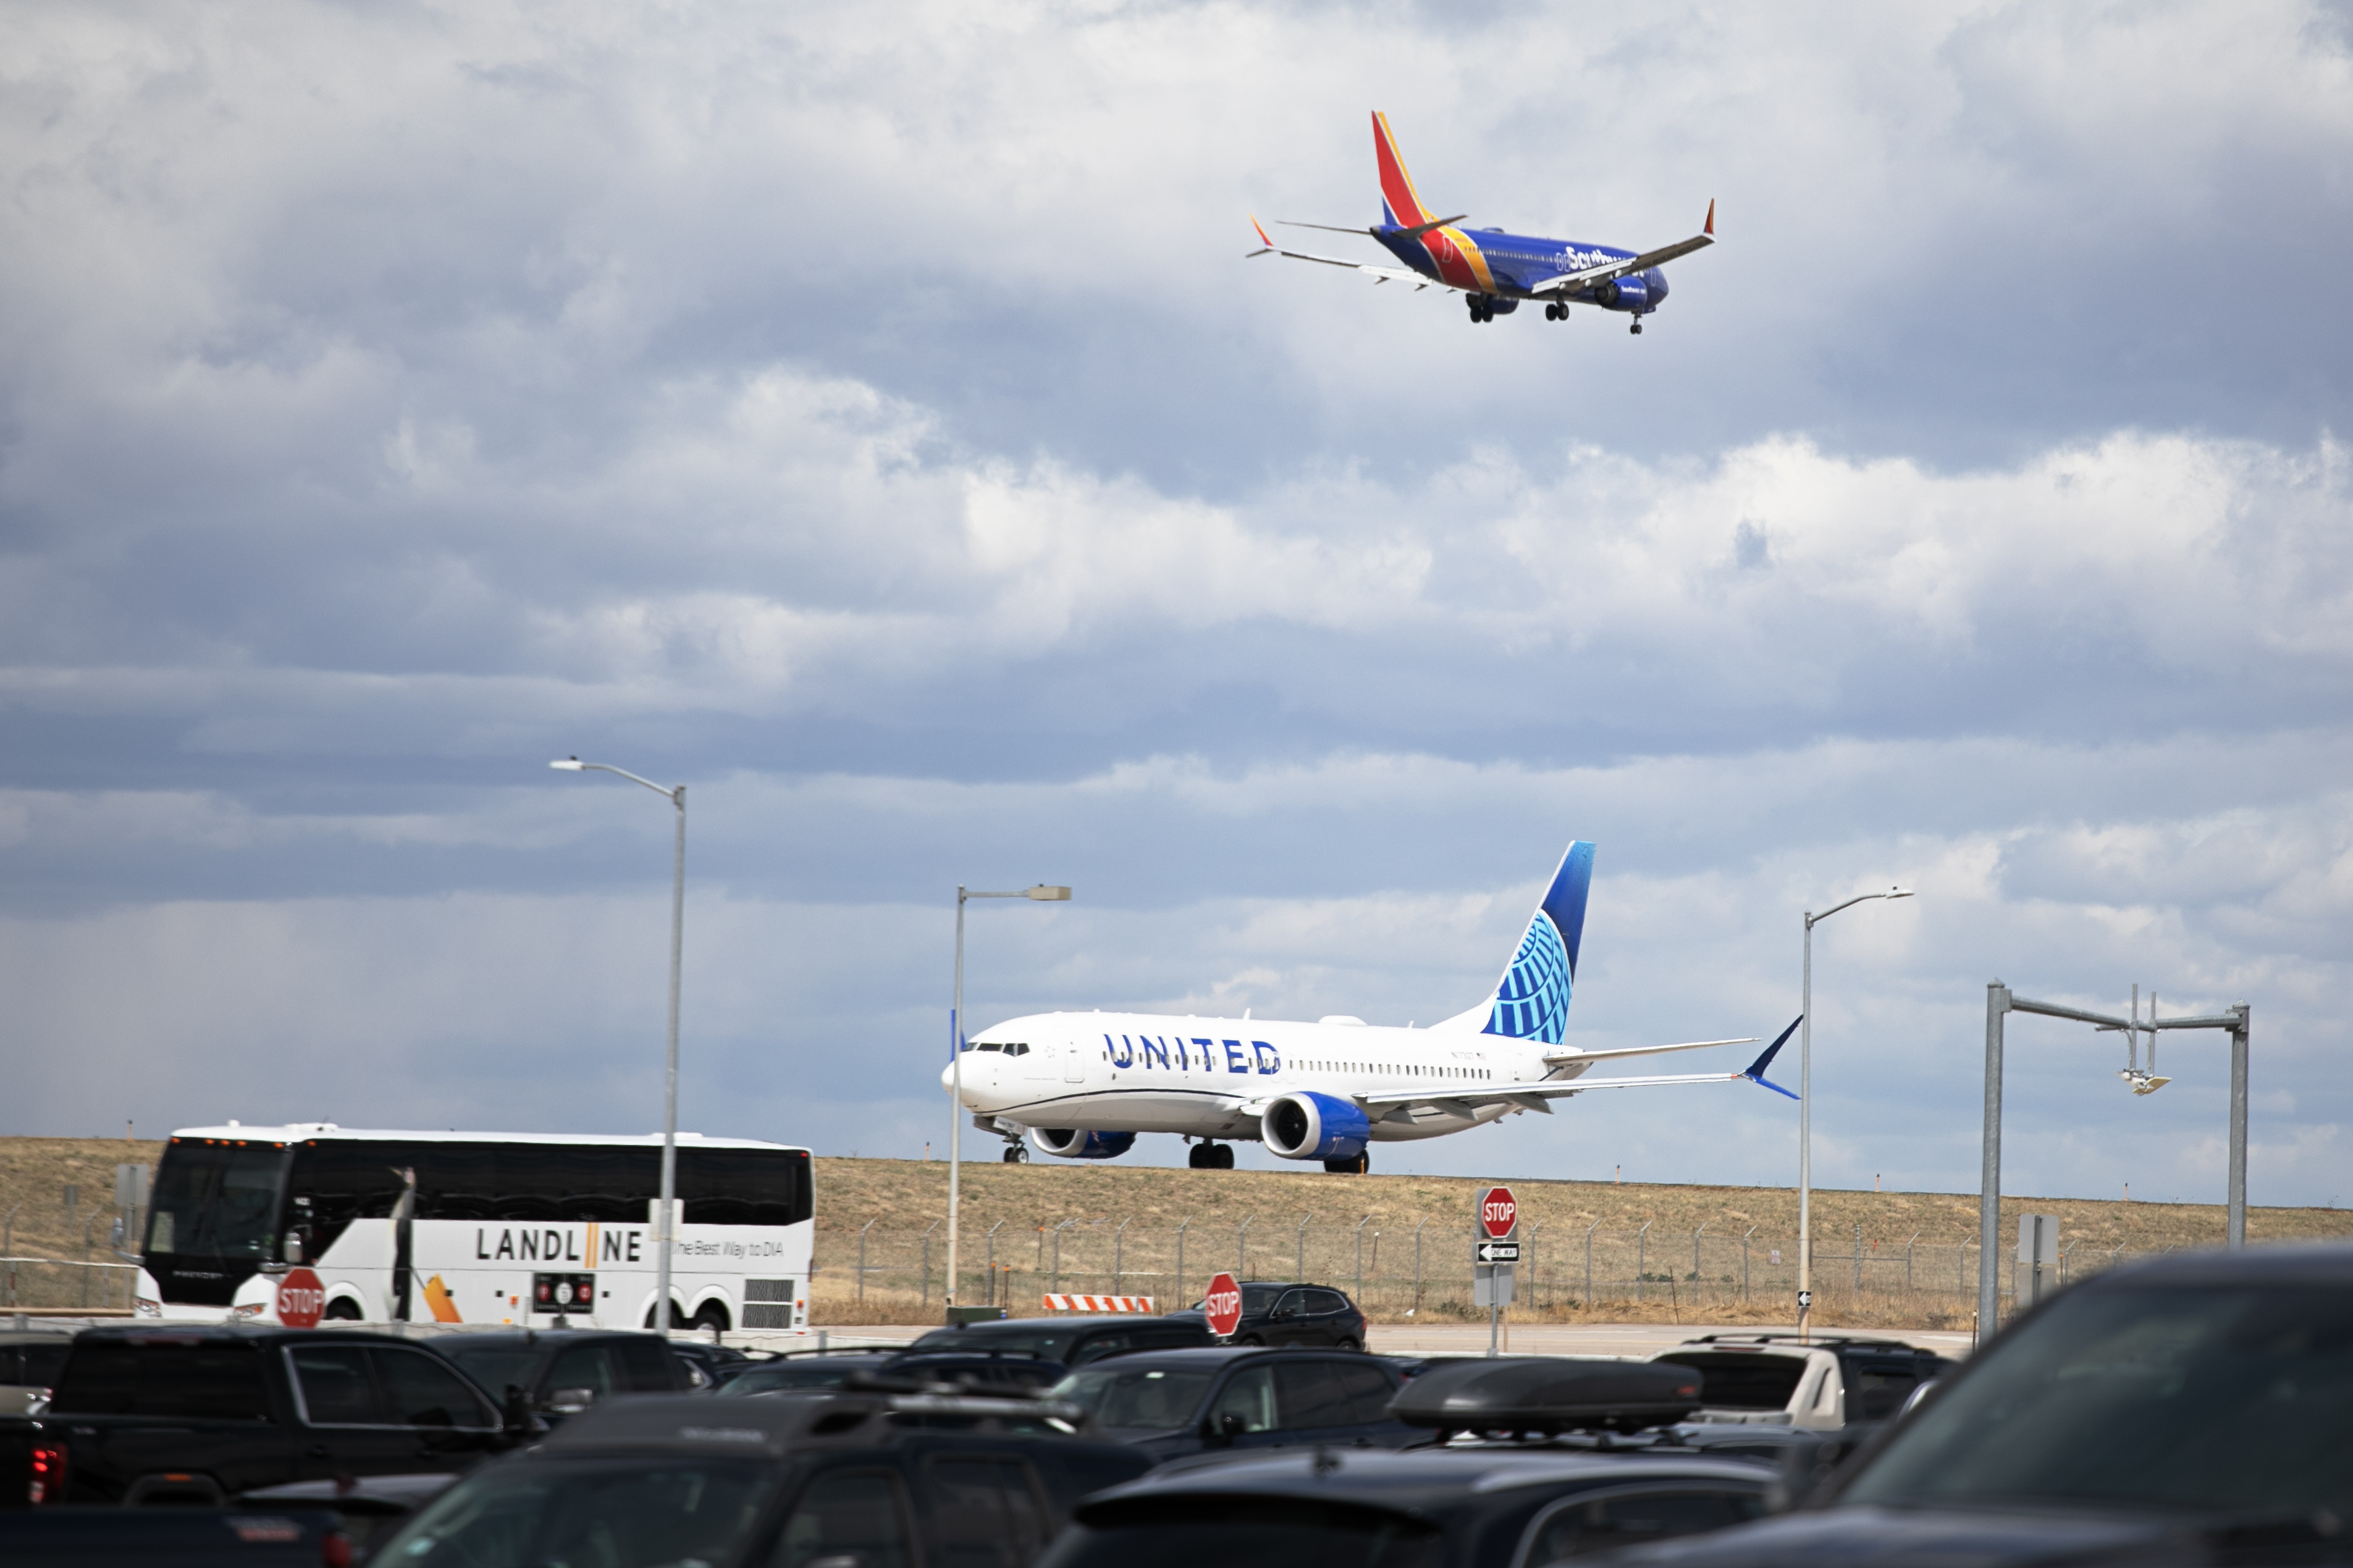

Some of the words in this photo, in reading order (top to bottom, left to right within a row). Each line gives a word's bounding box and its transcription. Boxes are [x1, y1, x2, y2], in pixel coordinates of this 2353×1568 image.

[1103, 1034, 1281, 1075] UNITED
[1485, 1202, 1515, 1222] STOP
[694, 1241, 720, 1255] Best
[723, 1241, 746, 1259] Way
[749, 1243, 762, 1256] to
[764, 1241, 784, 1256] DIA
[1491, 1248, 1502, 1256] ONE
[279, 1288, 324, 1314] STOP
[1208, 1291, 1239, 1317] STOP
